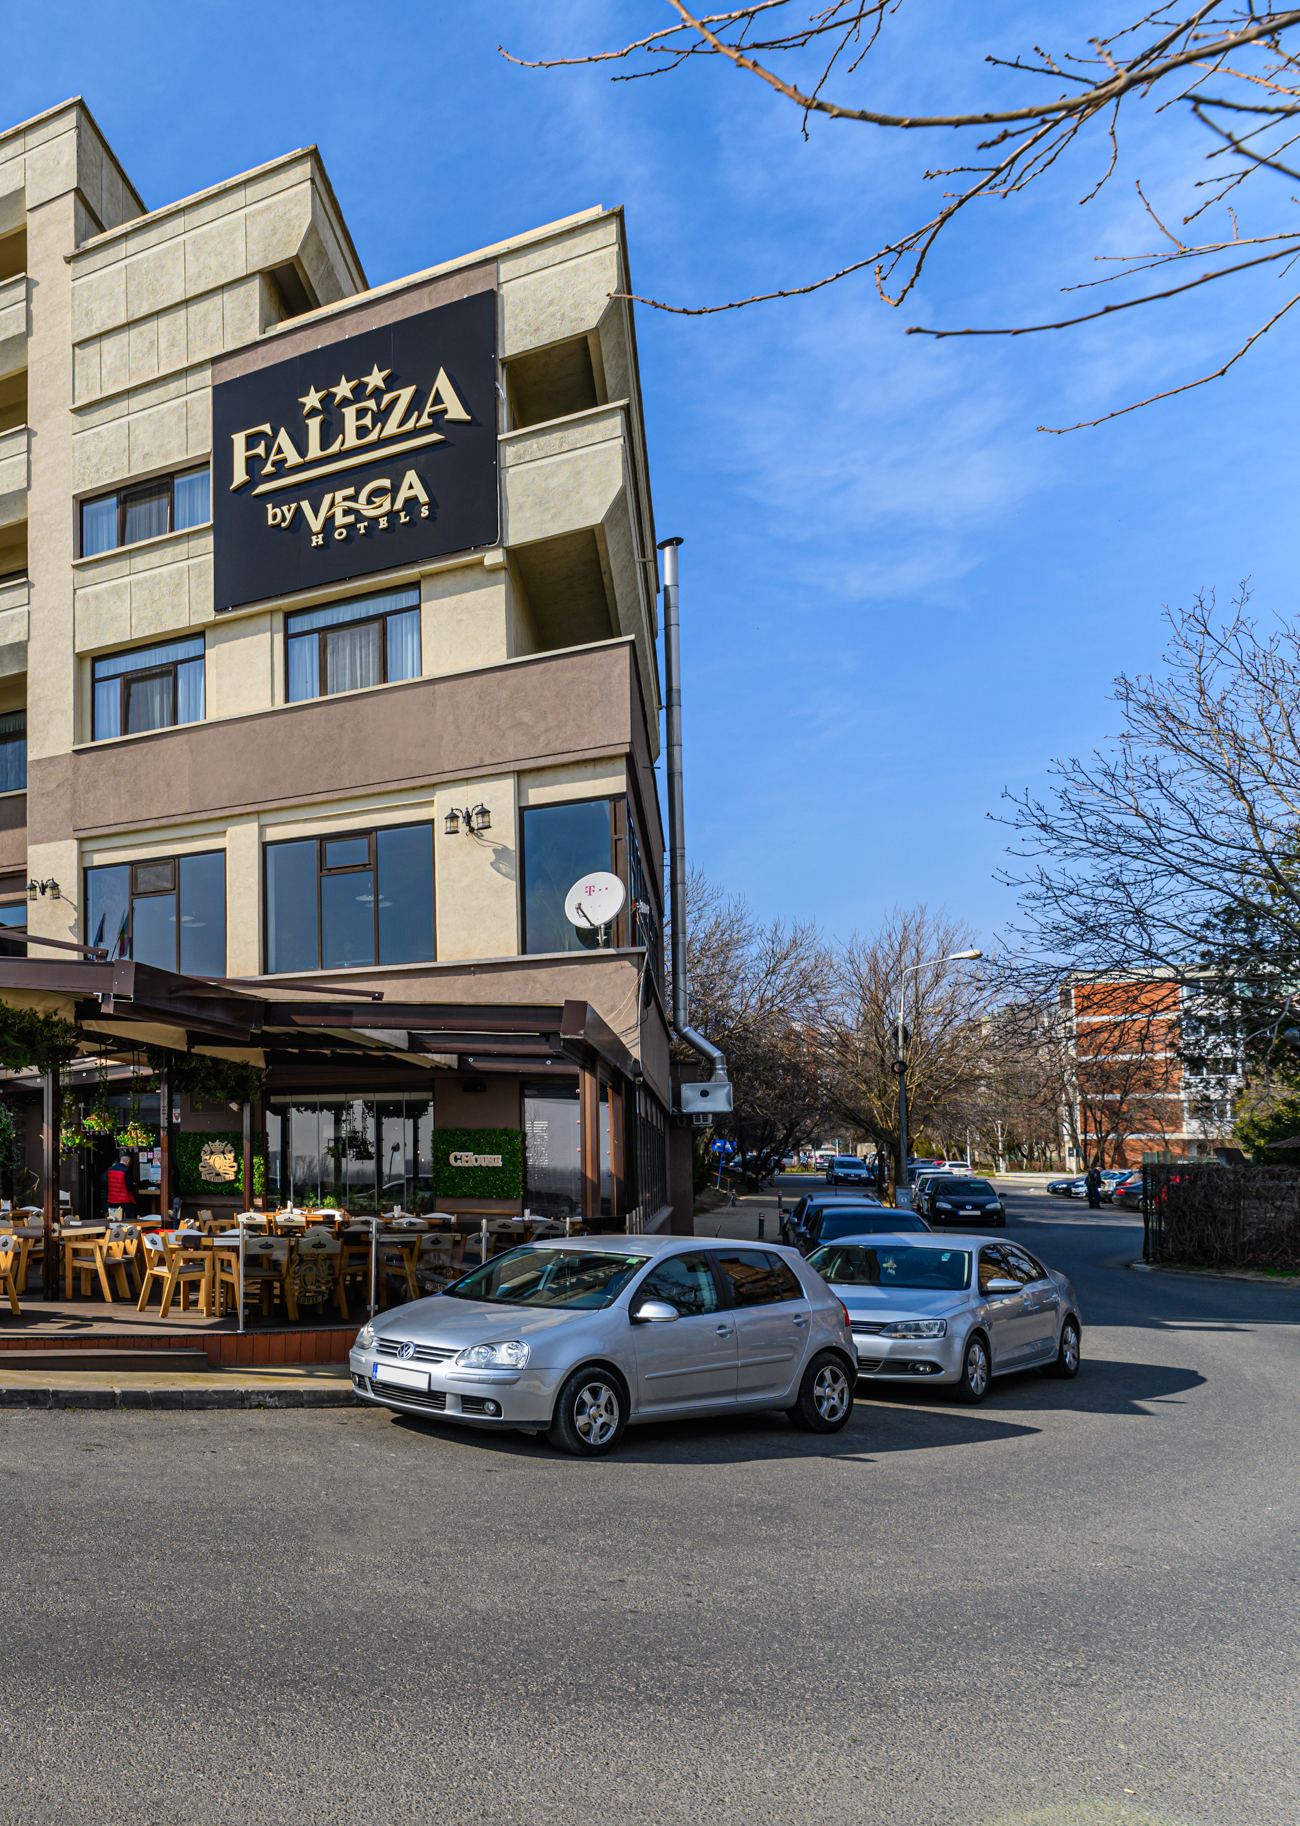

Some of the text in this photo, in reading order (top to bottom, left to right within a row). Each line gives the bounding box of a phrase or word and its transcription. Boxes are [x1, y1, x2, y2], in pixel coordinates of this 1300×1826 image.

[229, 366, 472, 492] FALEZA
[266, 469, 430, 534] by VEGA
[311, 505, 430, 547] HOTELS
